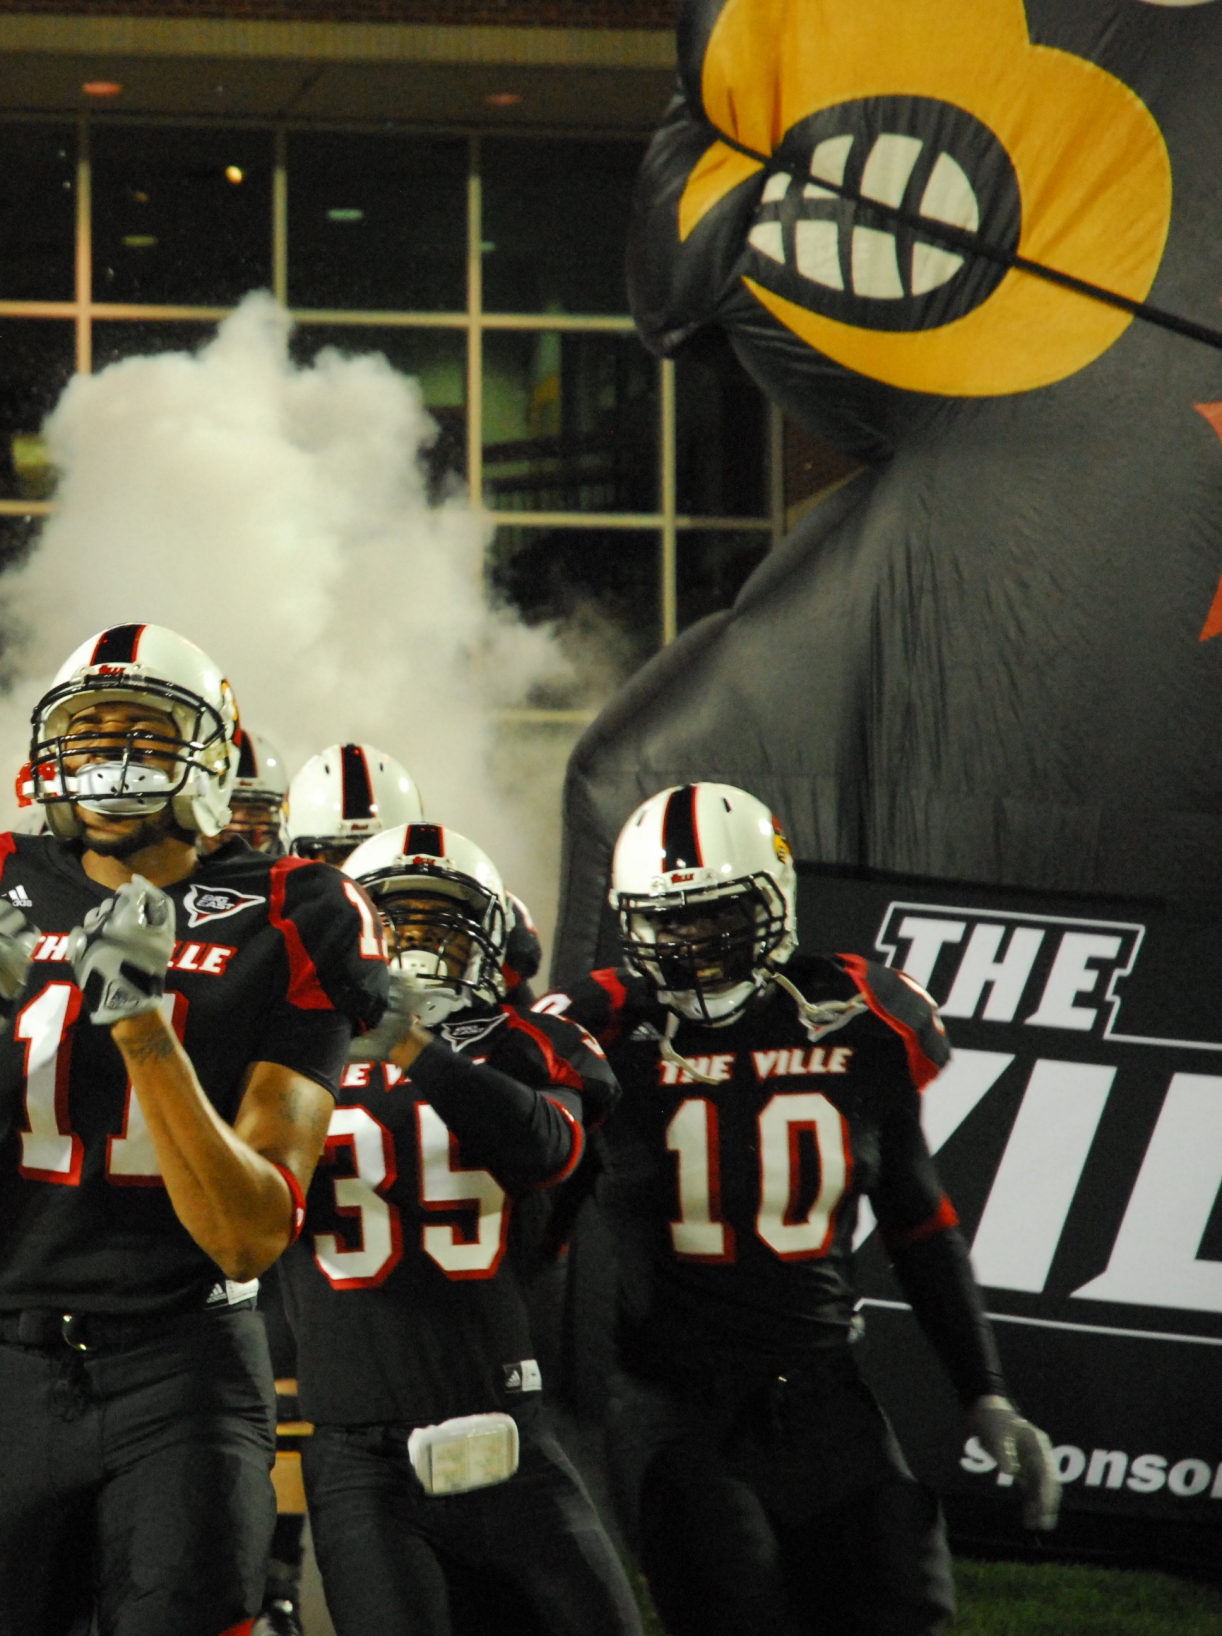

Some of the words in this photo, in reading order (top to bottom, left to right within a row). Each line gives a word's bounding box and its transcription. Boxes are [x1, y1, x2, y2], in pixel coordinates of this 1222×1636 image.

[341, 879, 390, 966] 1
[895, 916, 1123, 1032] THE
[658, 1052, 736, 1086] THE
[752, 1047, 854, 1083] VILLE
[314, 1100, 513, 1291] 35
[665, 1091, 854, 1264] 10
[959, 1435, 1222, 1499] sonso
